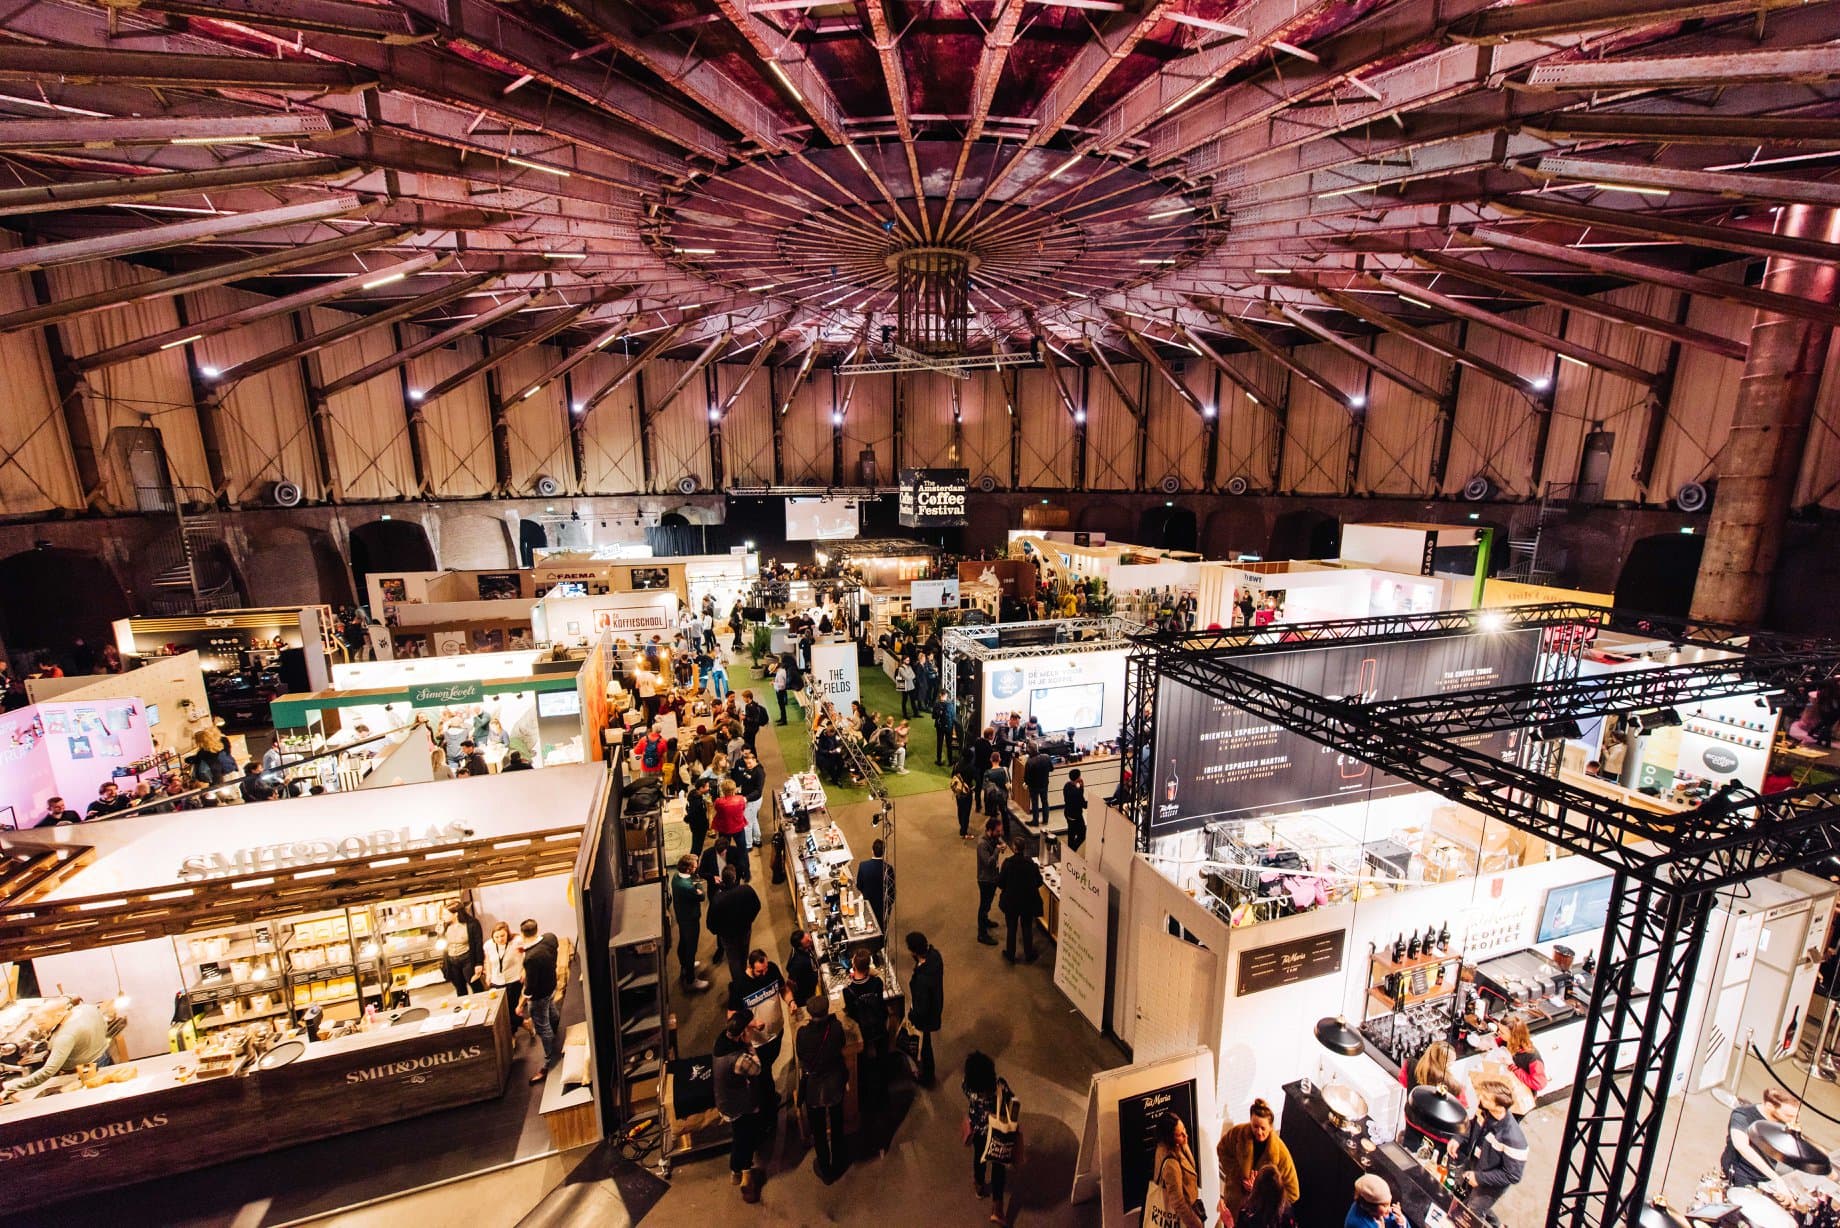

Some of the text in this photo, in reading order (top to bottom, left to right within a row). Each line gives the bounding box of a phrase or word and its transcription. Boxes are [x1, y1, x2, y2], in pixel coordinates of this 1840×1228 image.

[919, 484, 966, 492] Amsterdam
[917, 492, 965, 505] Coffee
[918, 505, 965, 516] Festival
[613, 616, 663, 628] KOFFIESCHOOL
[829, 669, 844, 680] THE
[823, 681, 851, 694] FIELDS
[416, 688, 449, 702] Simon
[1200, 729, 1232, 741] ORIENTAL
[1234, 726, 1268, 736] ESPRESSO
[1203, 756, 1287, 774] IRISH ESPRESSO MARTINI
[179, 819, 470, 882] SMIT&DORLAS
[346, 1044, 481, 1084] SMIT&DORLAS
[0, 1112, 169, 1162] SMIT&DORLAS
